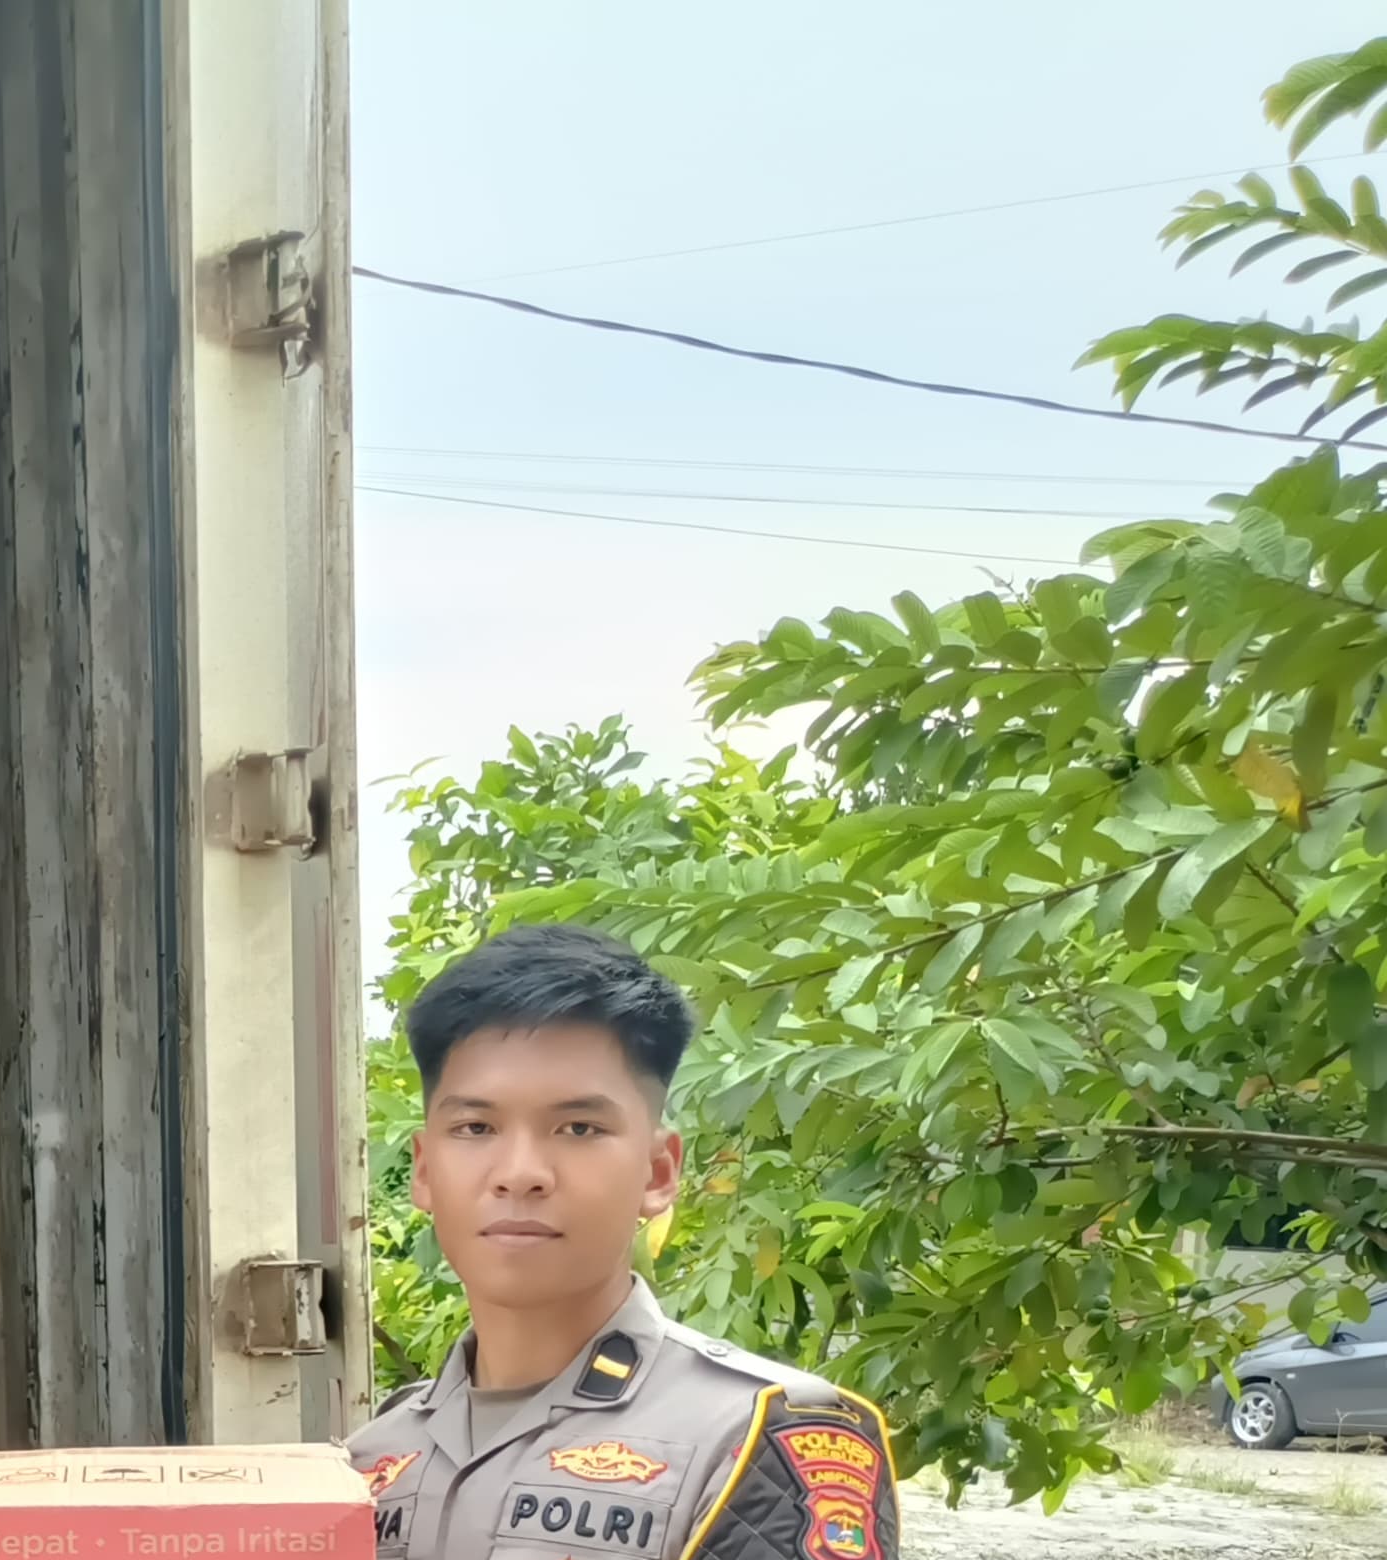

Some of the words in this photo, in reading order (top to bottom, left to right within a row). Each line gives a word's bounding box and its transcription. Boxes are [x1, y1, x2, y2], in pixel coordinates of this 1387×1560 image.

[789, 1433, 874, 1468] POLRES
[806, 1471, 870, 1494] LAMPUNG
[511, 1493, 654, 1548] POLRI
[121, 1528, 226, 1559] Tanpa
[237, 1526, 337, 1553] Iritasi
